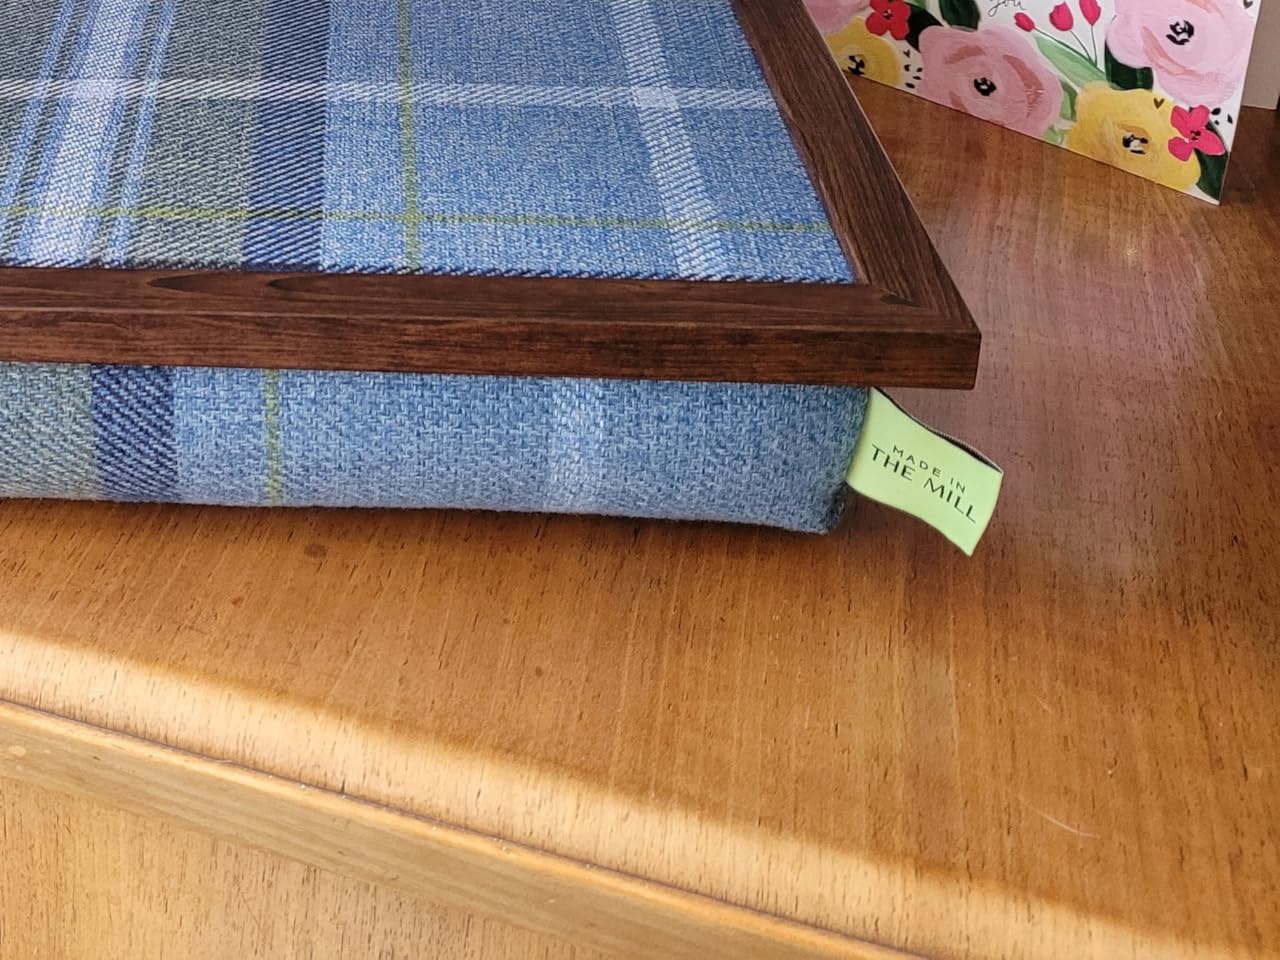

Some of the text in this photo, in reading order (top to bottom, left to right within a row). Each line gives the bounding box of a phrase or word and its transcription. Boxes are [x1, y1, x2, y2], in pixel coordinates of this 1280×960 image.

[871, 443, 977, 524] THE MILL
[892, 444, 966, 493] MADE IN
